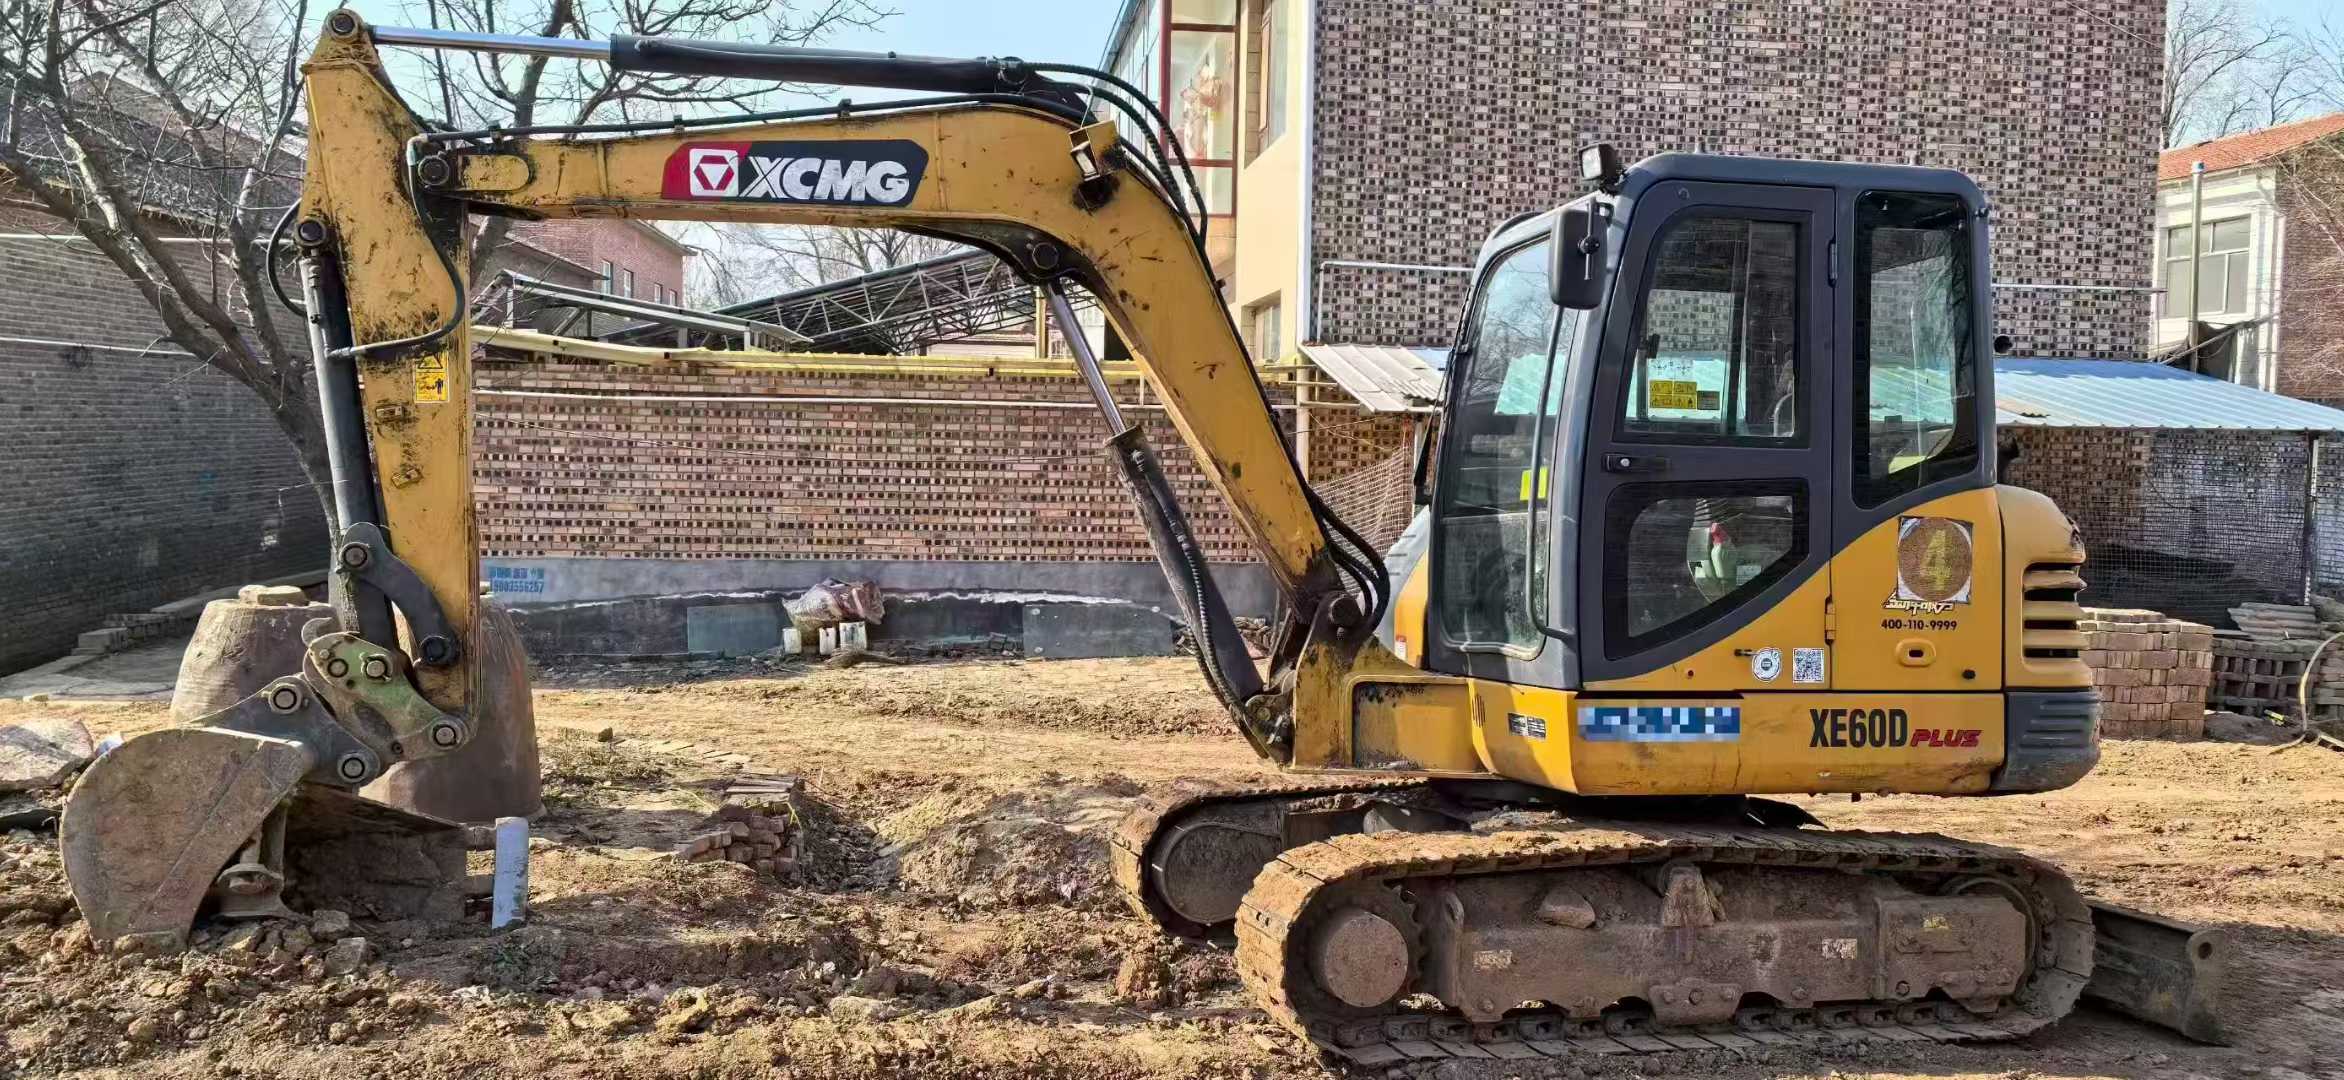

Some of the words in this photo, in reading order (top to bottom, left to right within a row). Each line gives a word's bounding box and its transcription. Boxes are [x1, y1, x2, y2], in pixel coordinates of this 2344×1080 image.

[739, 156, 910, 203] XCMG
[1920, 529, 1952, 592] 4
[1881, 619, 1958, 631] 400-110-9999
[1809, 708, 1909, 748] XE60D
[1909, 729, 1983, 748] PLUS
